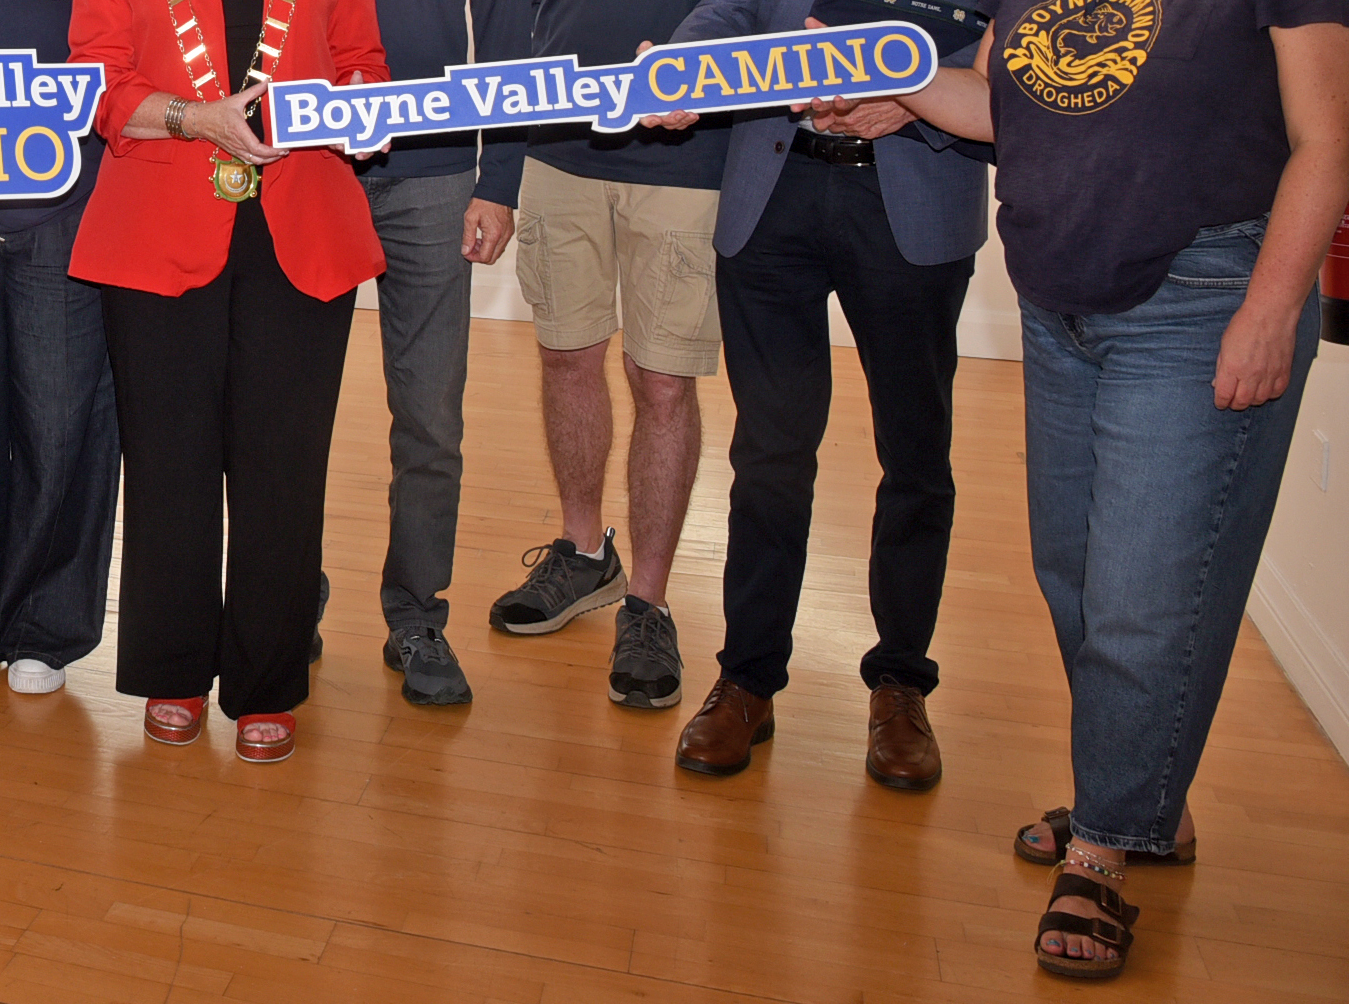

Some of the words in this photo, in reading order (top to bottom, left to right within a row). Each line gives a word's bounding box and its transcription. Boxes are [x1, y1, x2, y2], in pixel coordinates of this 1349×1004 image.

[285, 90, 450, 141] Boyne
[462, 67, 634, 118] Valley
[648, 33, 921, 103] CAMINO
[1022, 69, 1121, 108] DROGHEDA
